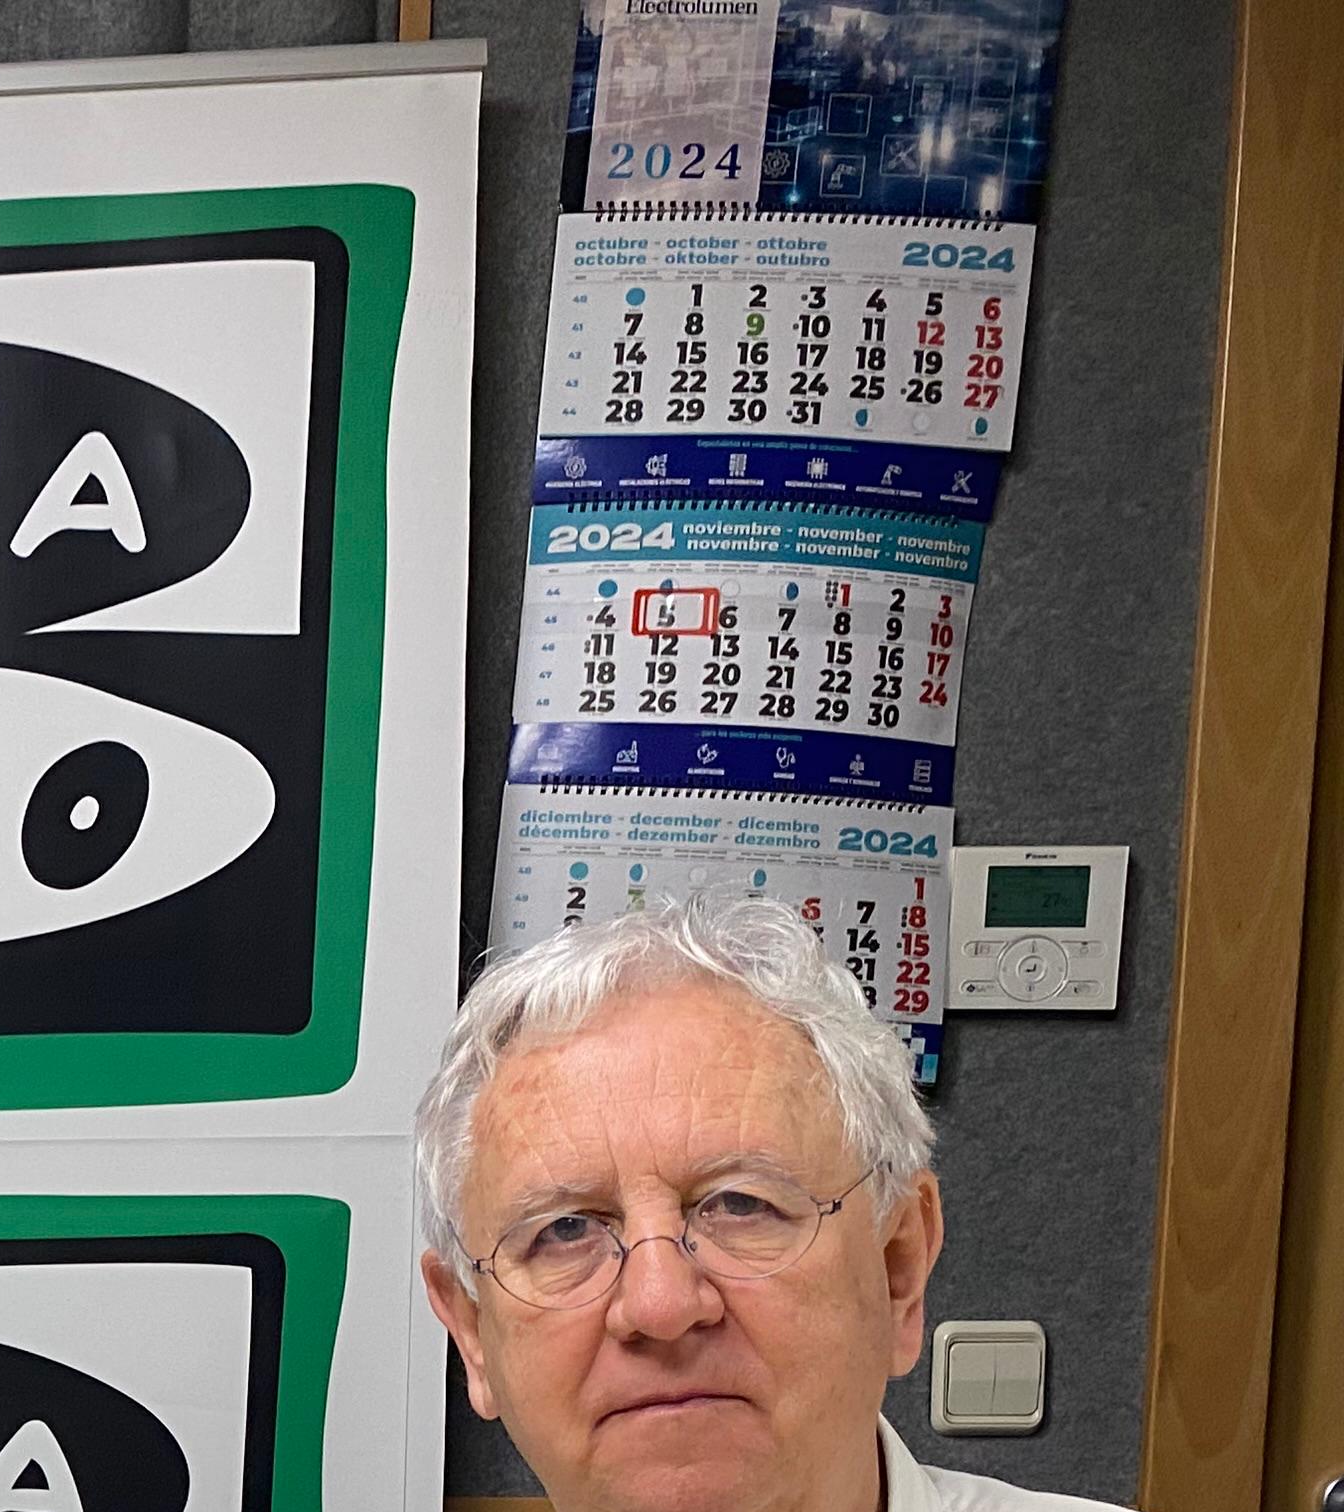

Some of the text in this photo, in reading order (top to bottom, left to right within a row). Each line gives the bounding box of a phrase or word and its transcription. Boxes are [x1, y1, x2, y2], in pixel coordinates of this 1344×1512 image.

[608, 143, 741, 179] 2024
[574, 253, 830, 266] octobre oktober outubro
[576, 237, 827, 250] octubre october ottobre
[902, 241, 1015, 273] 2024
[691, 284, 702, 306] 1
[749, 285, 767, 307] 2
[809, 286, 826, 309] 3
[866, 289, 887, 312] 4
[925, 293, 943, 315] 5
[984, 297, 1001, 320] 6
[624, 313, 643, 336] 7
[685, 313, 703, 335] 8
[747, 313, 764, 336] 9
[799, 315, 830, 338] 10
[862, 318, 885, 341] 11
[917, 321, 945, 345] 12
[975, 325, 1002, 349] 13
[614, 342, 647, 365] 14
[676, 341, 706, 364] 15
[737, 342, 768, 365] 16
[797, 344, 828, 367] 17
[856, 347, 886, 370] 18
[913, 351, 943, 374] 19
[967, 354, 1003, 378] 20
[612, 371, 642, 393] 21
[670, 370, 707, 393] 22
[732, 371, 768, 393] 23
[790, 372, 829, 396] 24
[850, 375, 885, 400] 25
[906, 379, 942, 404] 26
[964, 384, 1001, 409] 27
[606, 399, 643, 423] 28
[667, 399, 705, 422] 29
[728, 399, 767, 422] 30
[791, 401, 821, 424] 31
[547, 521, 675, 554] 2024
[683, 521, 970, 555] noviembre november novembre
[688, 538, 968, 570] novembre november novembro
[841, 584, 851, 606] 1
[890, 588, 905, 612] 2
[938, 595, 952, 618] 3
[595, 605, 616, 627] 4
[719, 606, 738, 628] 6
[778, 608, 796, 631] 7
[833, 612, 851, 635] 8
[886, 618, 902, 641] 9
[931, 623, 953, 648] 10
[591, 634, 614, 656] 11
[649, 634, 679, 656] 12
[710, 634, 740, 657] 13
[768, 637, 799, 660] 14
[826, 641, 852, 665] 15
[878, 645, 904, 670] 16
[927, 652, 951, 676] 17
[584, 662, 615, 684] 18
[645, 662, 676, 684] 19
[703, 663, 741, 686] 20
[766, 666, 794, 689] 21
[819, 669, 852, 694] 22
[872, 674, 902, 699] 23
[919, 681, 947, 707] 24
[579, 690, 615, 712] 25
[639, 690, 676, 713] 26
[701, 691, 738, 713] 27
[759, 694, 795, 718] 28
[815, 698, 849, 722] 29
[868, 703, 899, 727] 30
[520, 810, 819, 833] diciembre december dicembre
[628, 828, 718, 843] dezember
[735, 833, 819, 848] dezembro
[838, 827, 938, 858] 2024
[915, 877, 924, 900] 1
[567, 887, 586, 909] 2
[857, 901, 875, 923] 7
[909, 906, 926, 928] 8
[847, 928, 879, 953] 14
[902, 933, 929, 957] 15
[846, 957, 930, 985] 21 22
[894, 988, 930, 1013] 29
